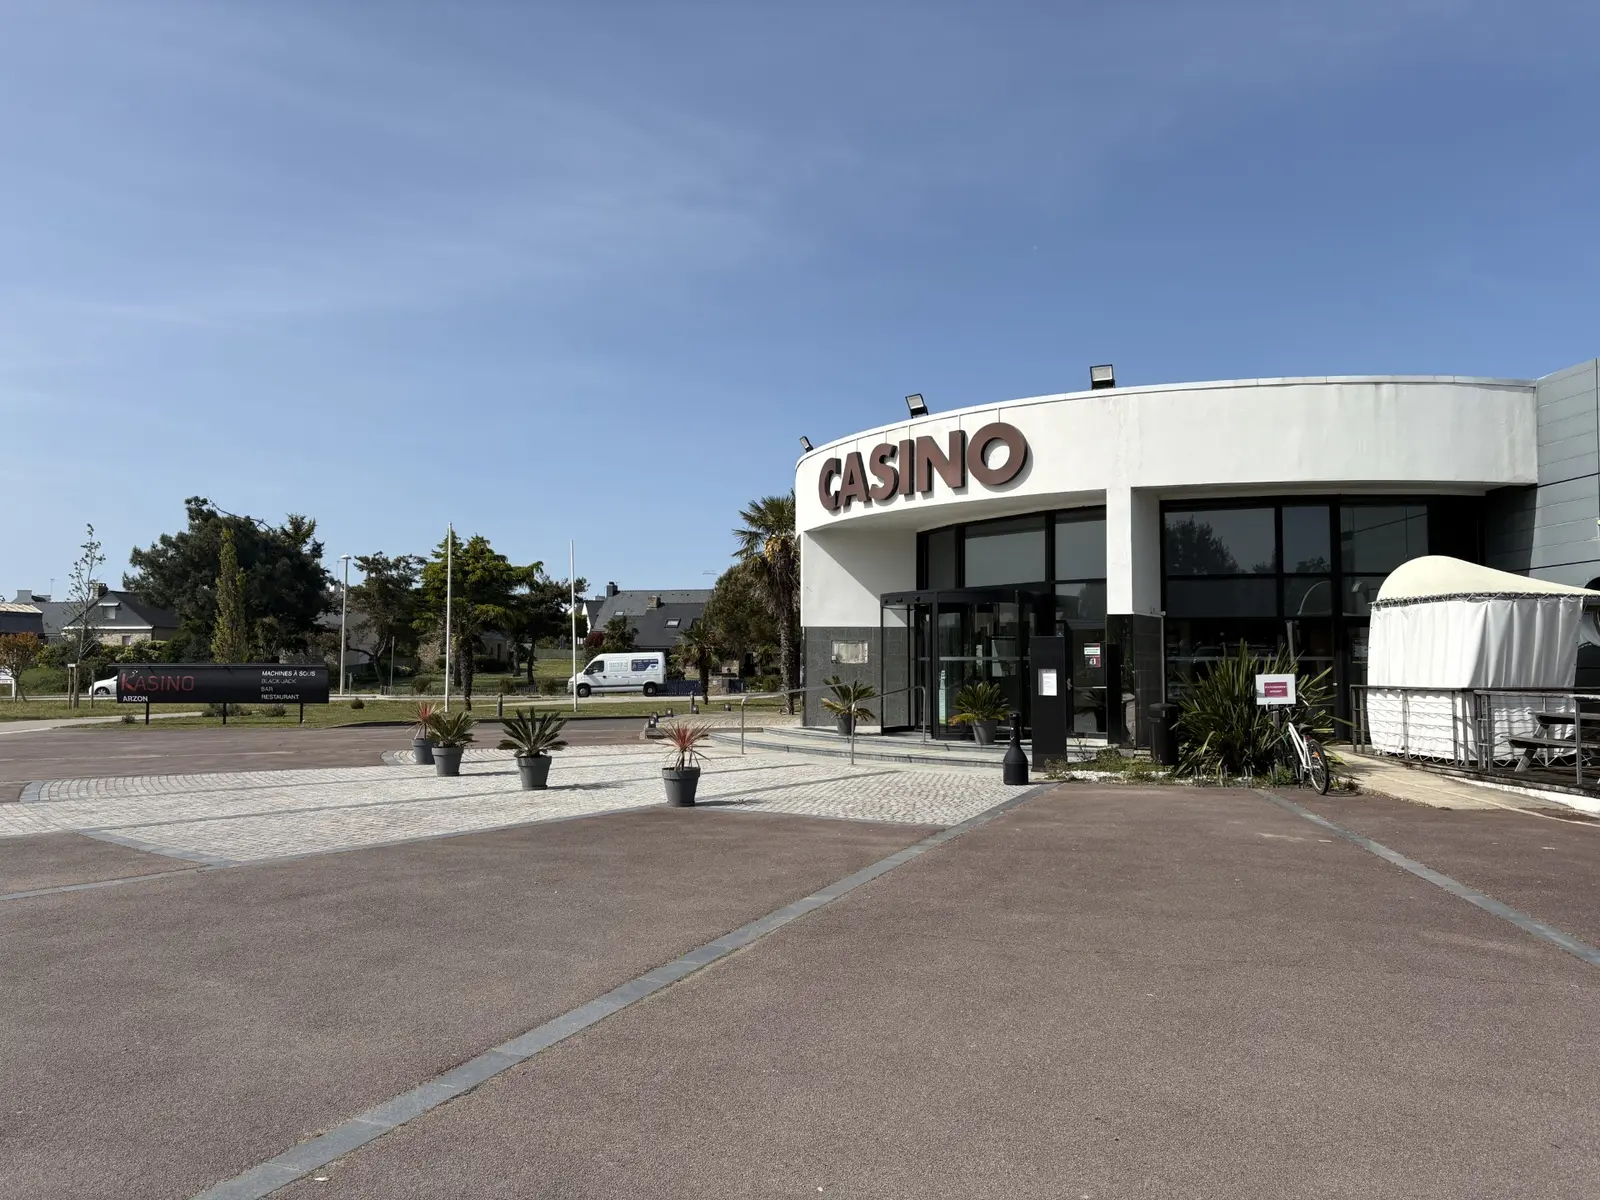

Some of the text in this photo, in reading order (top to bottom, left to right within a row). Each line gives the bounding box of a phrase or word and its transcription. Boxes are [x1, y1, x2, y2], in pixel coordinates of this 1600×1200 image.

[818, 422, 1029, 512] CASINO
[121, 672, 195, 691] KASINO
[293, 669, 298, 677] À
